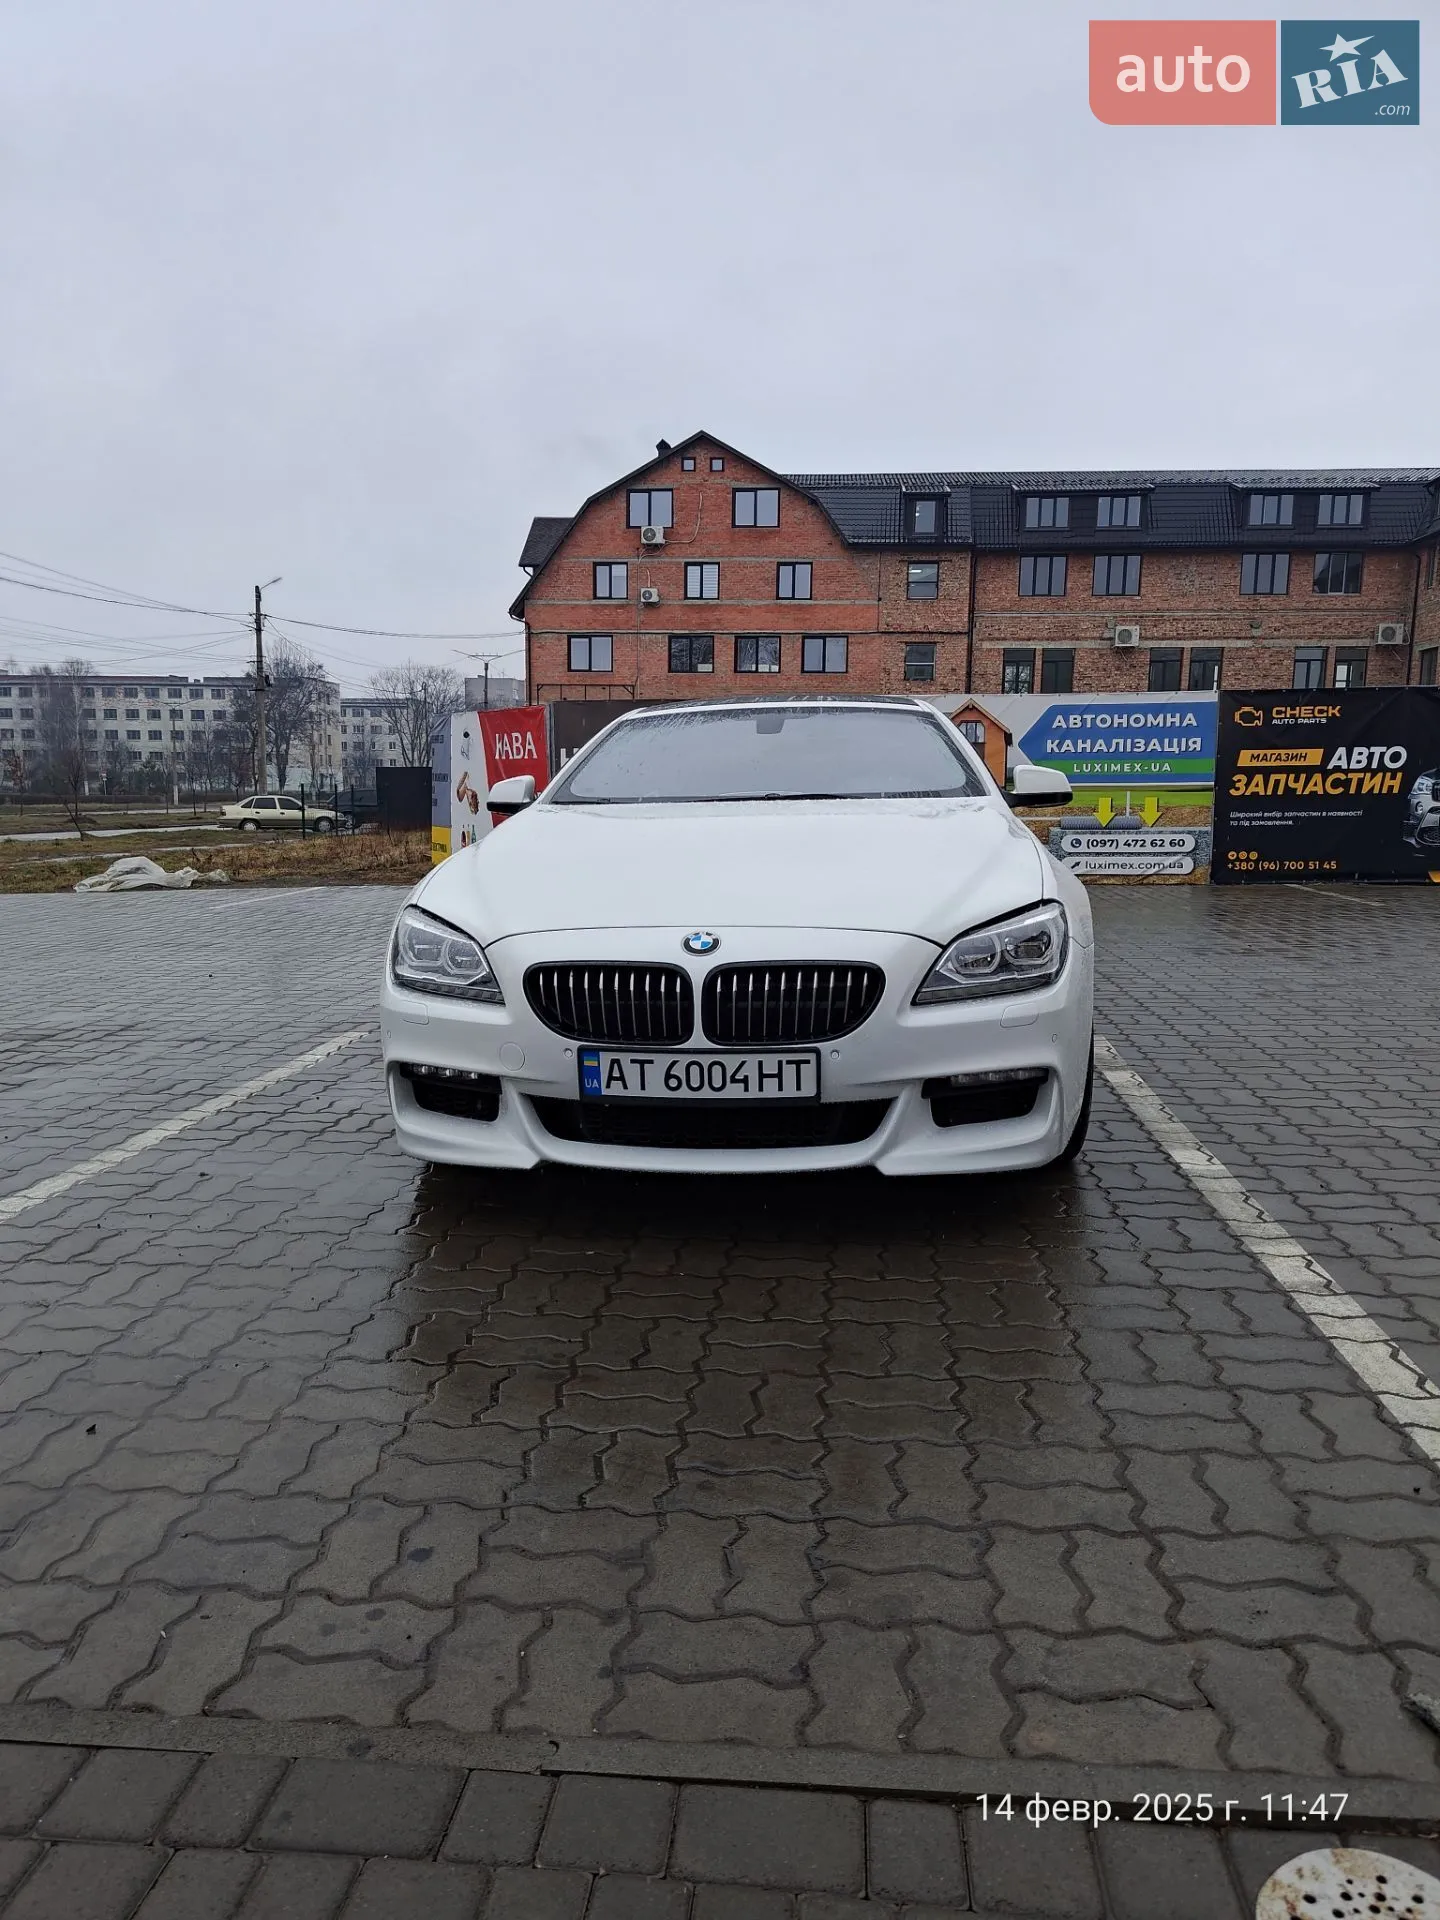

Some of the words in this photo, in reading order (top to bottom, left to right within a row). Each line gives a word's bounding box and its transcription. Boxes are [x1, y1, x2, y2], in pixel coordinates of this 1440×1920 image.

[1272, 705, 1341, 718] CHECK
[1052, 712, 1198, 729] АВТОНОМНА
[1046, 737, 1202, 754] КАНАЛІЗАЦІЯ
[1249, 752, 1308, 763] МАГАЗИН
[1327, 746, 1408, 770] АВТО
[1073, 763, 1172, 773] LUXIMEX-UA
[1229, 772, 1403, 796] ЗАПЧАСТИН
[1086, 838, 1119, 850] (097)
[1123, 838, 1147, 848] 472
[1150, 838, 1165, 848] 62
[1169, 838, 1186, 848] 60
[1085, 859, 1184, 871] luximex.com.ua
[1228, 862, 1255, 870] +380
[1259, 861, 1280, 871] (96)
[1283, 861, 1304, 869] 700
[1308, 861, 1319, 869] 51
[1323, 861, 1337, 869] 45
[605, 1058, 654, 1091] AT
[663, 1060, 750, 1092] 6004
[757, 1059, 811, 1092] HT
[584, 1079, 600, 1089] UA
